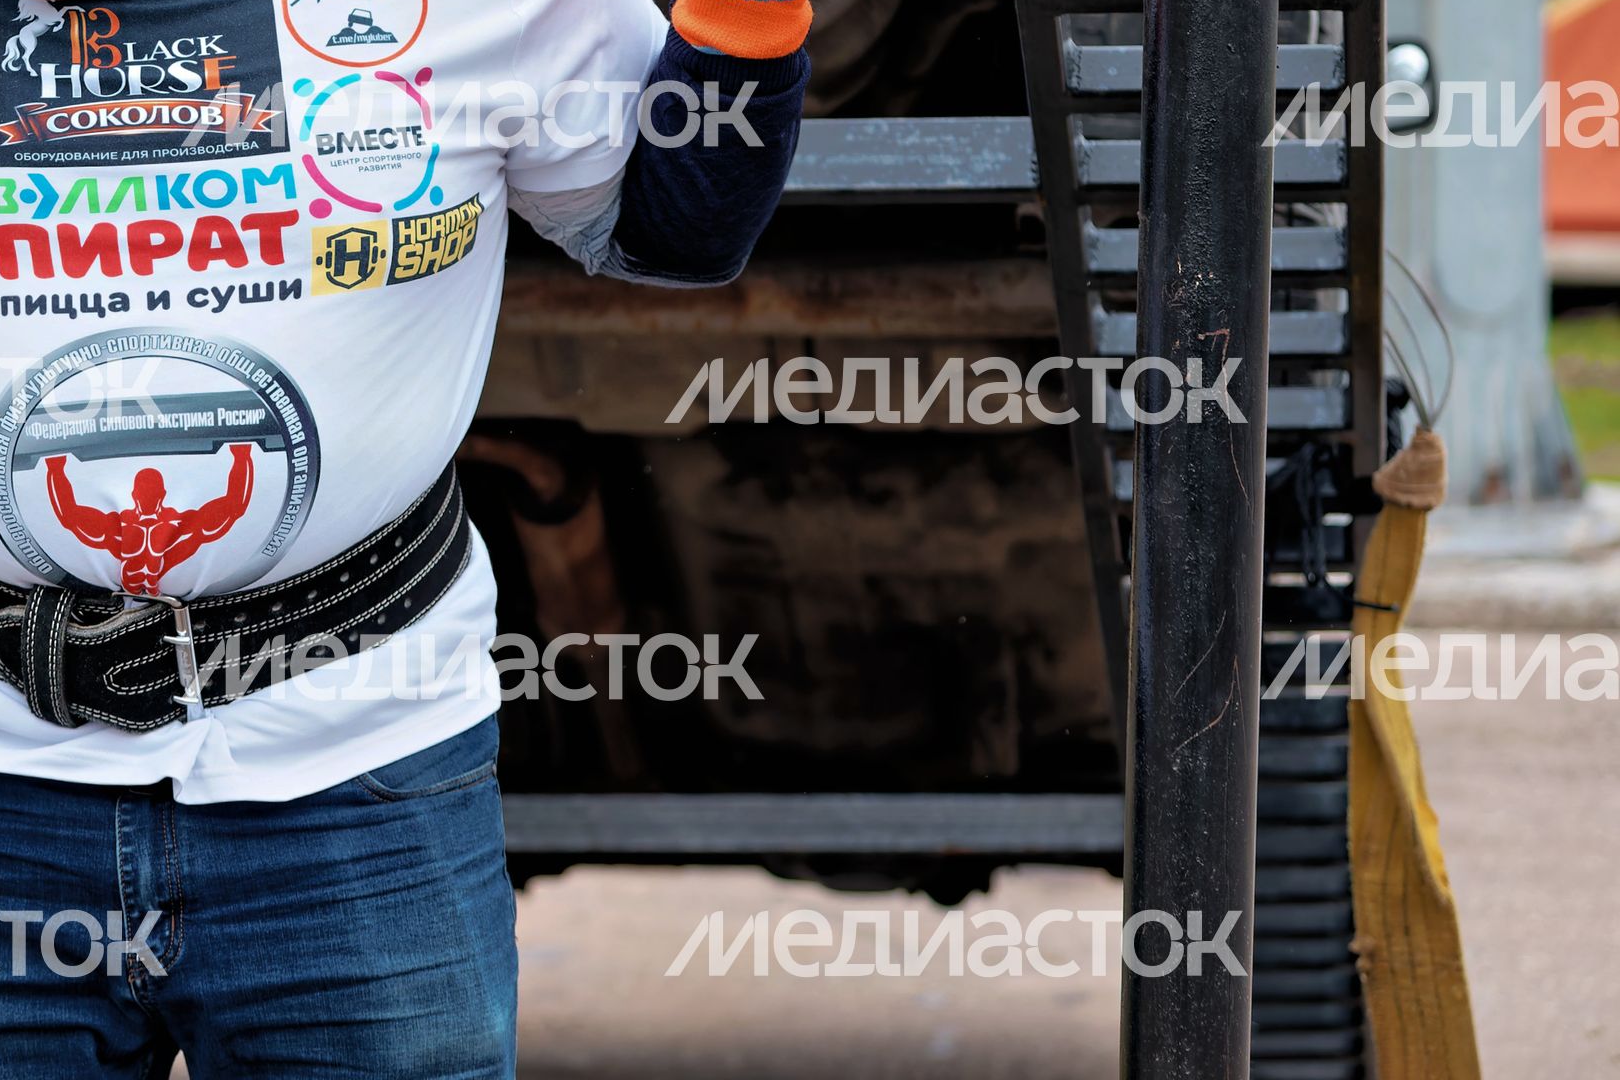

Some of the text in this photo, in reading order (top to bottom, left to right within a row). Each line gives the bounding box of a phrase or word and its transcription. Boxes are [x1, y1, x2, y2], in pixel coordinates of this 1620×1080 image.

[69, 7, 228, 69] BLACK
[332, 33, 392, 44] t.me/myluber
[40, 56, 238, 99] HORSE
[46, 105, 224, 133] СОКОЛОВ
[14, 141, 259, 162] ОБОРУДОВАНИЕ ДЛЯ ПРОИЗВОДСТВА
[316, 125, 426, 156] ВМЕСТЕ
[330, 152, 422, 168] ЦЕНТР СПОРТИВНОГО
[358, 163, 402, 172] РАЗВИТИЯ
[398, 196, 482, 244] HORMON
[395, 220, 477, 279] SHOP
[0, 278, 302, 320] пицца и суши
[99, 414, 154, 432] силового
[158, 411, 213, 431] экстрима
[217, 407, 267, 427] России»
[261, 444, 309, 557] организация
